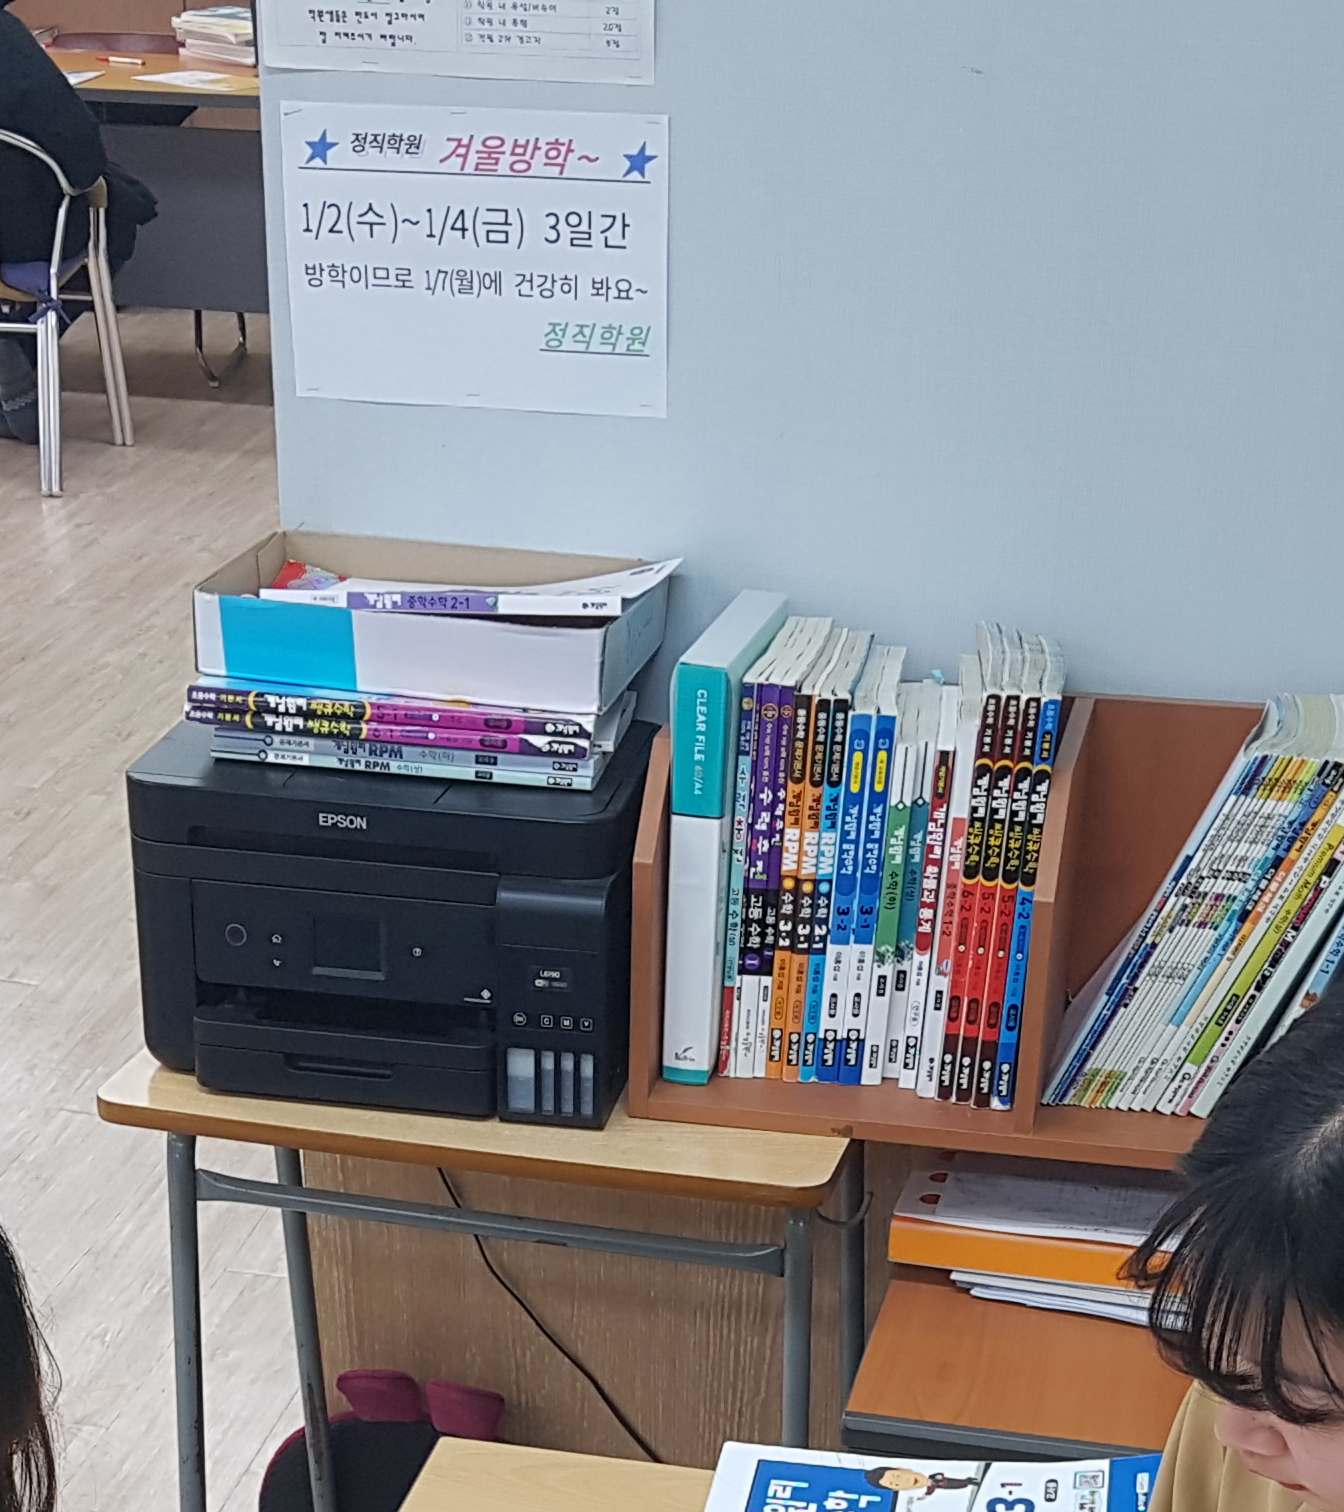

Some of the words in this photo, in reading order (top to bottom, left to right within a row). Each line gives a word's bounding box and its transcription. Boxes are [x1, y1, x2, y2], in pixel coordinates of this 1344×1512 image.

[350, 132, 422, 155] 정직학원
[439, 134, 599, 174] 겨울방학~
[301, 201, 524, 249] 1/2(수)~1/4(금)
[544, 211, 630, 249] 3일간
[304, 262, 414, 290] 방학이므로
[425, 270, 502, 296] 1/7(월)에
[514, 273, 577, 300] 건강히
[591, 276, 648, 302] 봐요~
[543, 321, 651, 352] 정직학원
[451, 598, 469, 610] 2-1
[217, 712, 240, 722] 기본서
[696, 689, 707, 731] CLEAR
[369, 744, 403, 760] RPM
[694, 735, 705, 761] FILE
[365, 760, 390, 772] RPM
[972, 773, 990, 817] 개념원리
[993, 775, 1010, 819] 개념원리
[1012, 777, 1031, 822] 개념원리
[1031, 779, 1049, 824] 개념원리
[319, 812, 367, 831] EPSON
[926, 803, 947, 858] 개념원리
[782, 828, 799, 871] RPM
[801, 832, 818, 874] RPM
[818, 832, 836, 874] RPM
[1306, 841, 1334, 881] Premium
[961, 890, 975, 912] 6-2
[1293, 877, 1311, 902] Math
[748, 894, 762, 920] 고등
[780, 892, 793, 914] 수학
[801, 896, 813, 918] 수학
[816, 897, 828, 918] 수학
[980, 893, 994, 914] 5-2
[1000, 895, 1014, 918] 5-2
[1018, 897, 1031, 920] 4-2
[836, 906, 850, 931] 3-2
[860, 906, 873, 929] 3-1
[918, 908, 932, 933] 통계
[942, 920, 952, 937] 1-2
[748, 923, 761, 948] 수학
